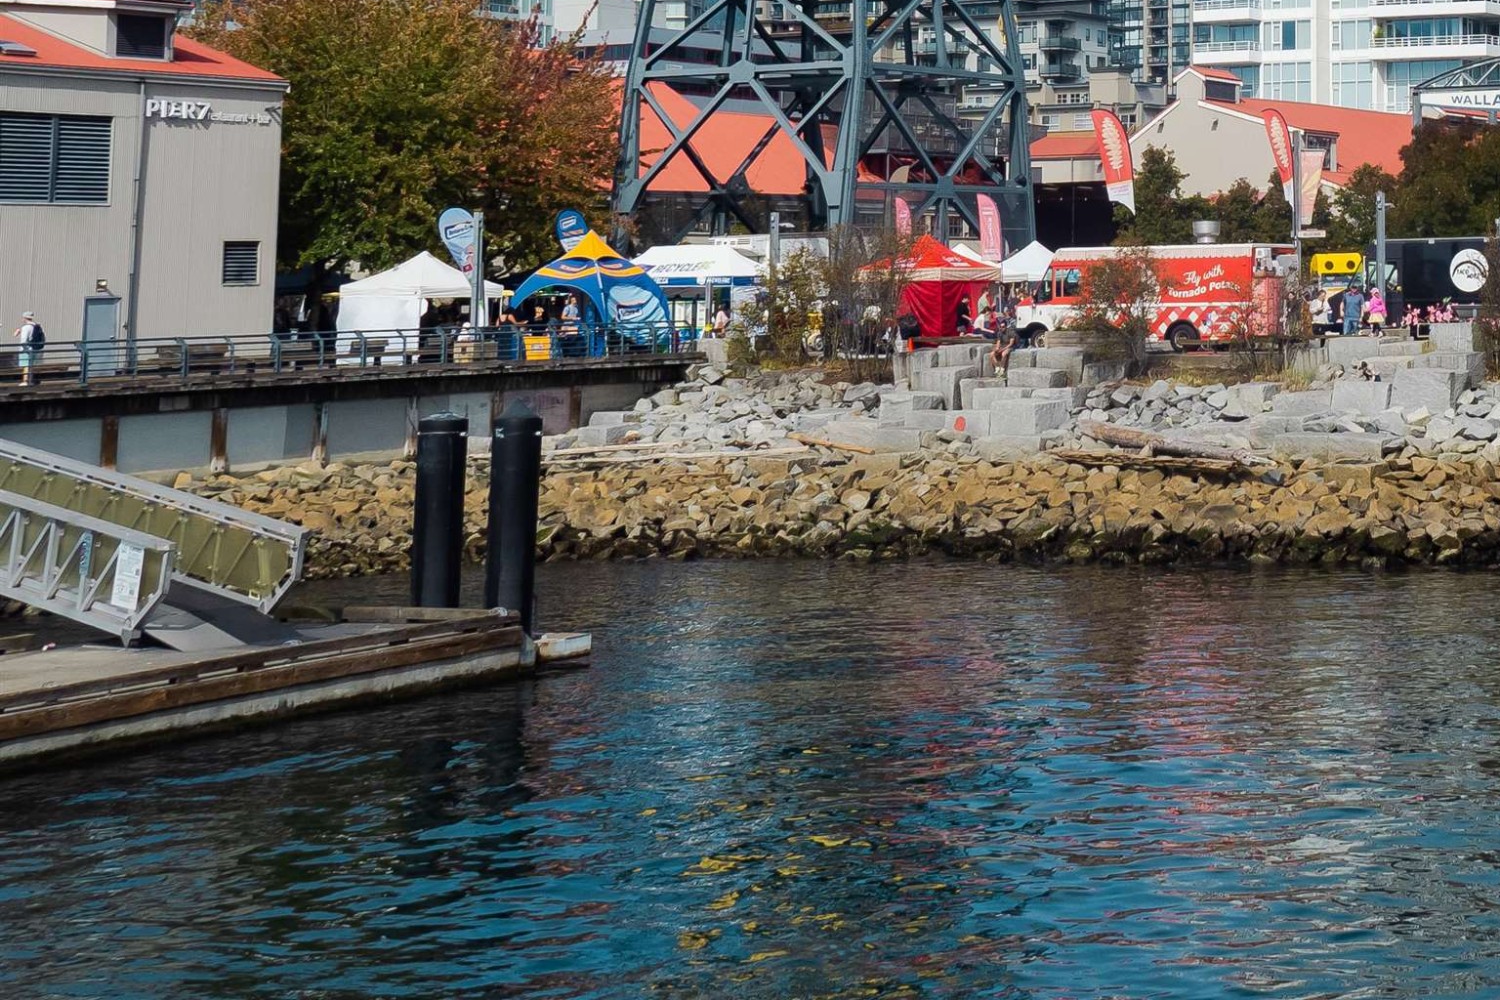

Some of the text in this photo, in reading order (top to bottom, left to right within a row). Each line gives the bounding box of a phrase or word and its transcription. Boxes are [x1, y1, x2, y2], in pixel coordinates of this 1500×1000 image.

[1183, 263, 1225, 286] Fly with
[1167, 285, 1206, 298] Tornado
